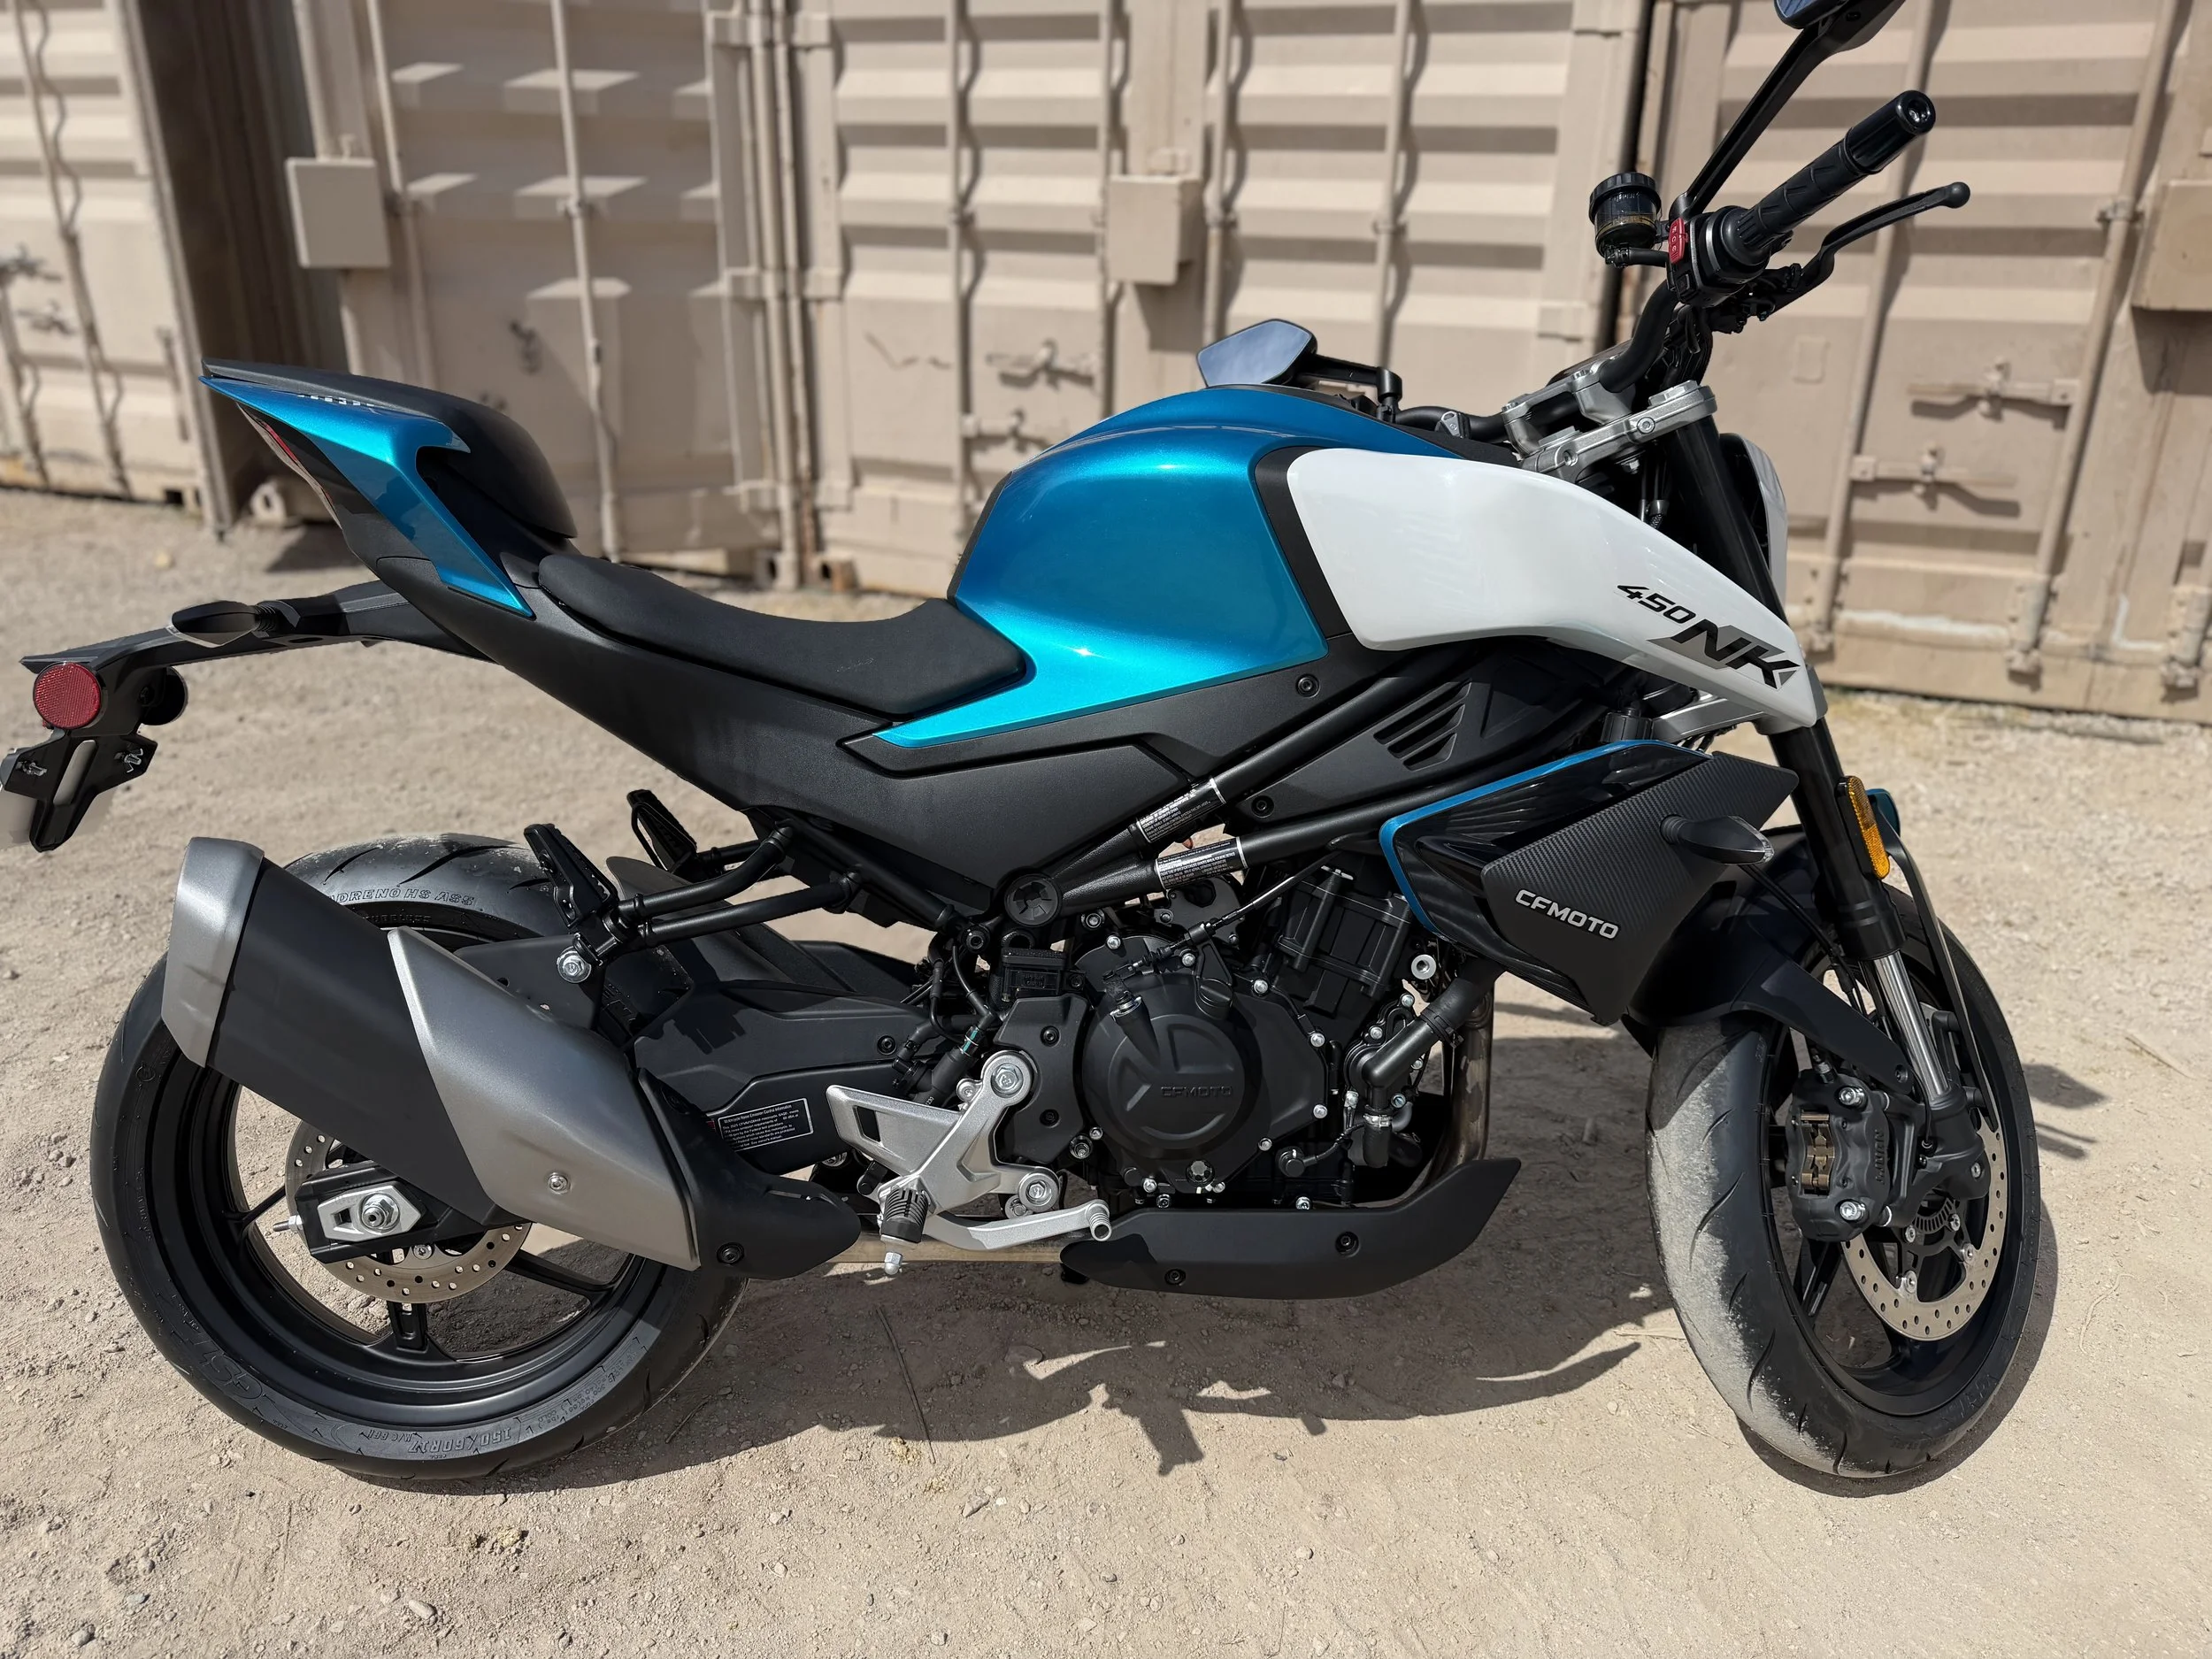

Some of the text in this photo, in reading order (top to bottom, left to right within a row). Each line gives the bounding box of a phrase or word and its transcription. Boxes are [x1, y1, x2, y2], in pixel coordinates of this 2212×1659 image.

[1617, 585, 1696, 624] 450
[1671, 618, 1801, 689] NK
[403, 887, 431, 899] HS
[1516, 889, 1618, 939] CFMOTO
[1161, 1087, 1233, 1097] CFMOTO
[406, 1425, 511, 1454] 150/60R17
